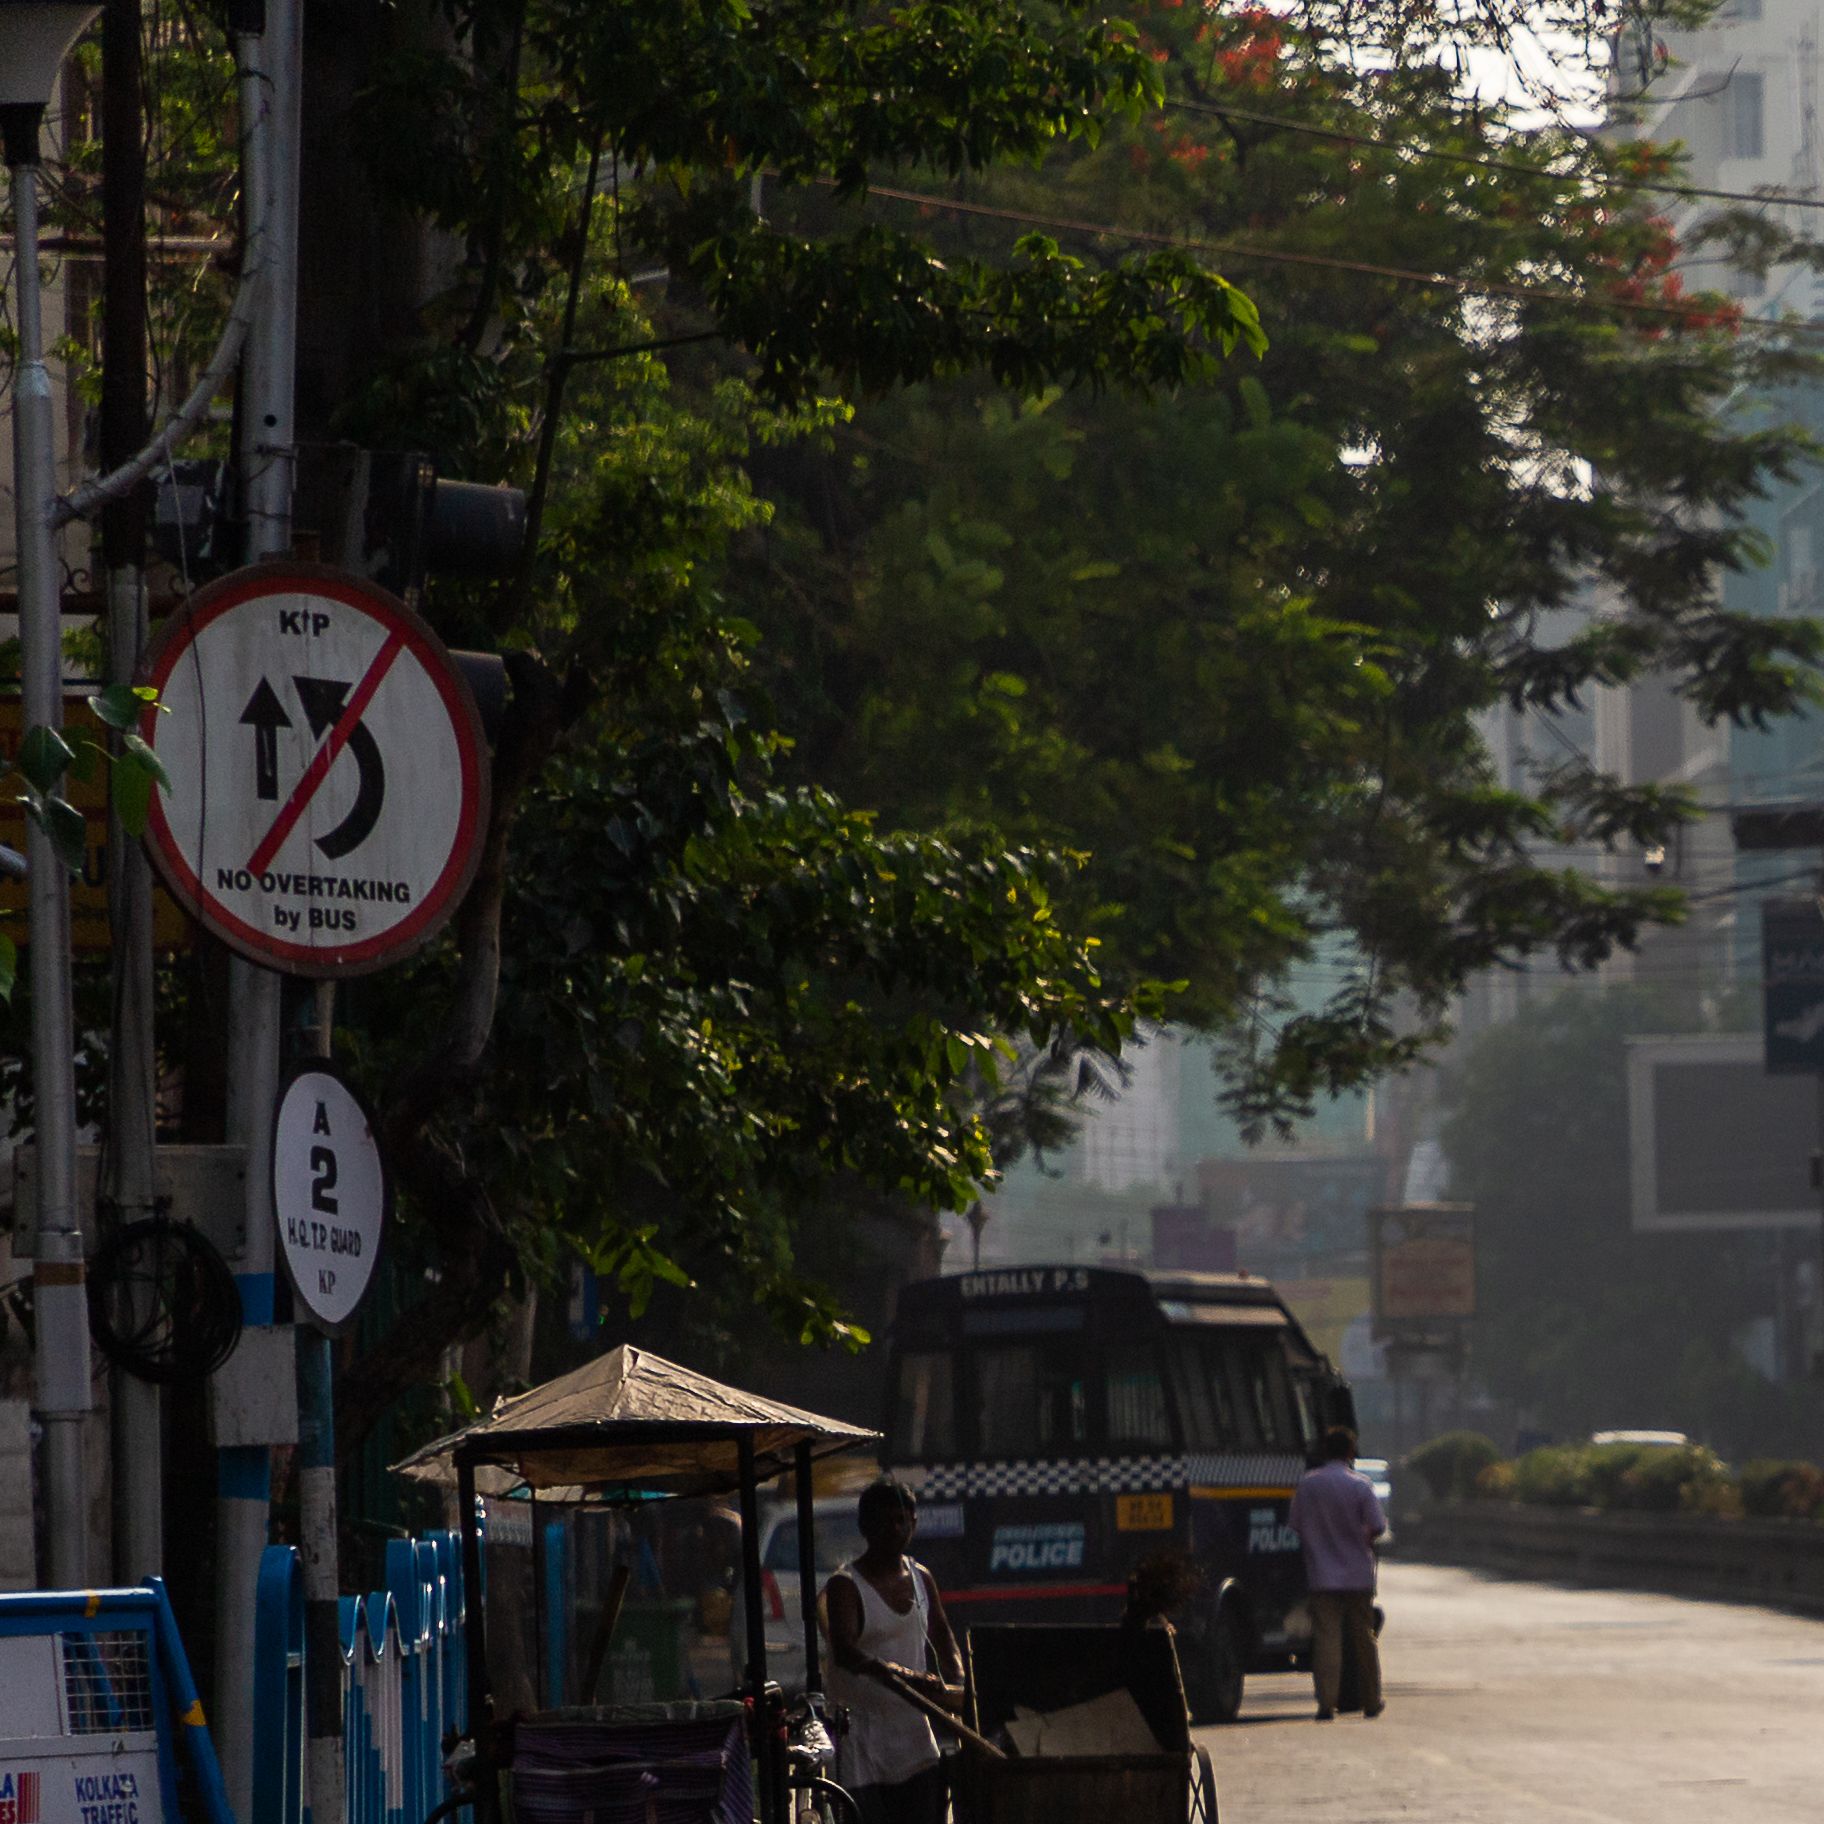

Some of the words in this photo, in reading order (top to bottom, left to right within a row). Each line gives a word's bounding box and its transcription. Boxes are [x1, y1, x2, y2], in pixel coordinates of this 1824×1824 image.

[218, 868, 252, 892] NO
[259, 872, 411, 903] OVERTAKING
[274, 906, 301, 931] by
[309, 908, 356, 931] BUS
[313, 1102, 331, 1136] A
[311, 1145, 338, 1215] 2
[331, 1226, 362, 1258] GUARD
[318, 1269, 337, 1295] KP
[990, 1539, 1084, 1572] POLICE
